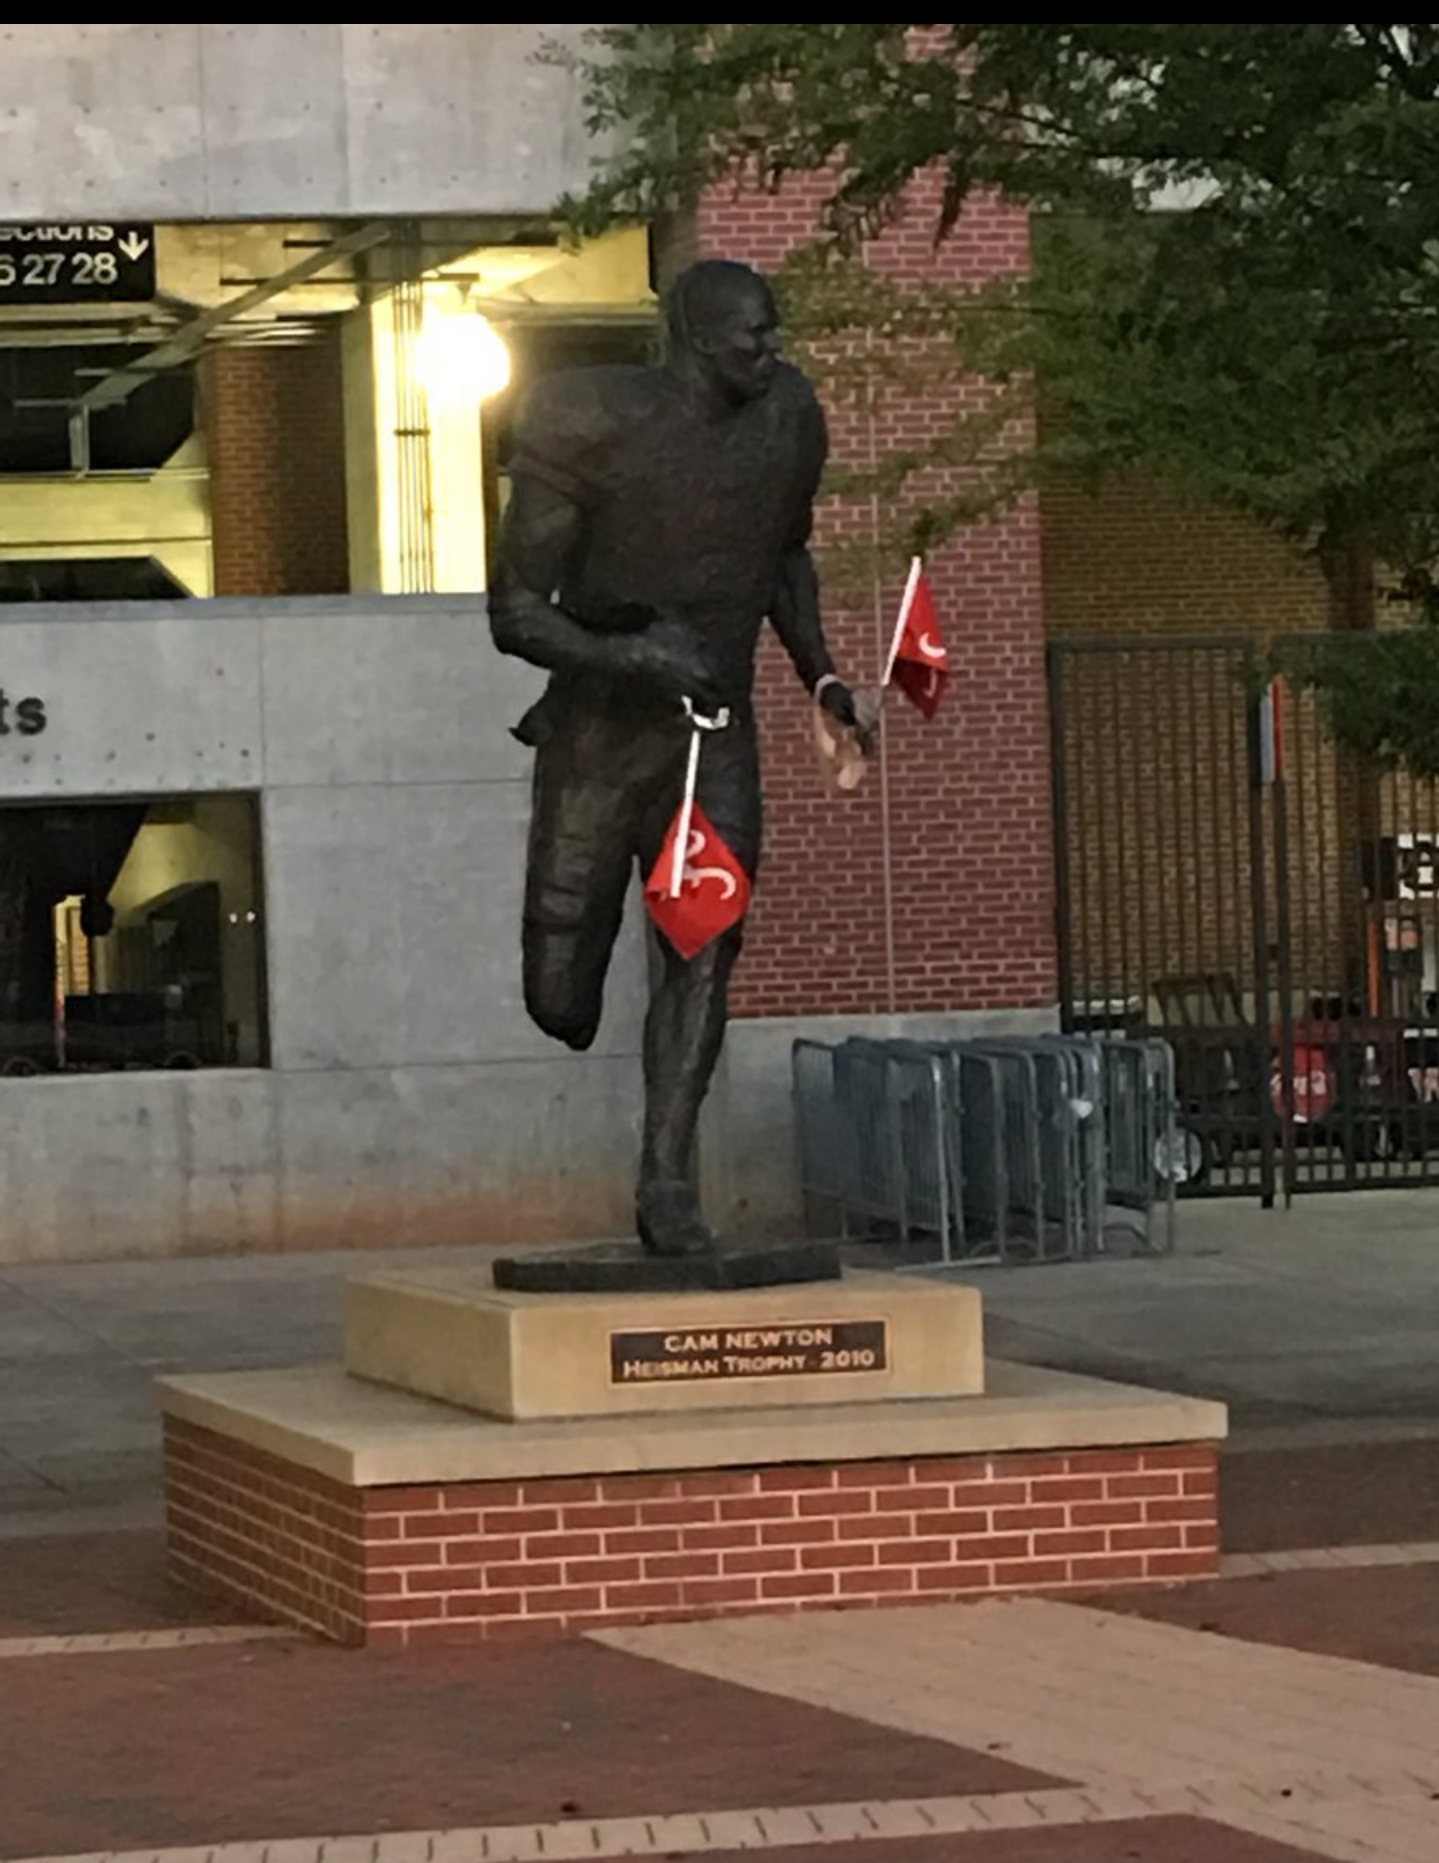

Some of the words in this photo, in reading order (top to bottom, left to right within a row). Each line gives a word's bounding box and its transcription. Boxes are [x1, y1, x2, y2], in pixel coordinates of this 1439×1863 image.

[22, 253, 65, 285] 27
[71, 252, 118, 285] 28
[664, 1334, 719, 1352] CAM
[725, 1328, 833, 1350] NEWTON
[623, 1359, 719, 1379] HEISMAN
[722, 1354, 807, 1373] TROPHY
[820, 1349, 875, 1369] 2010
